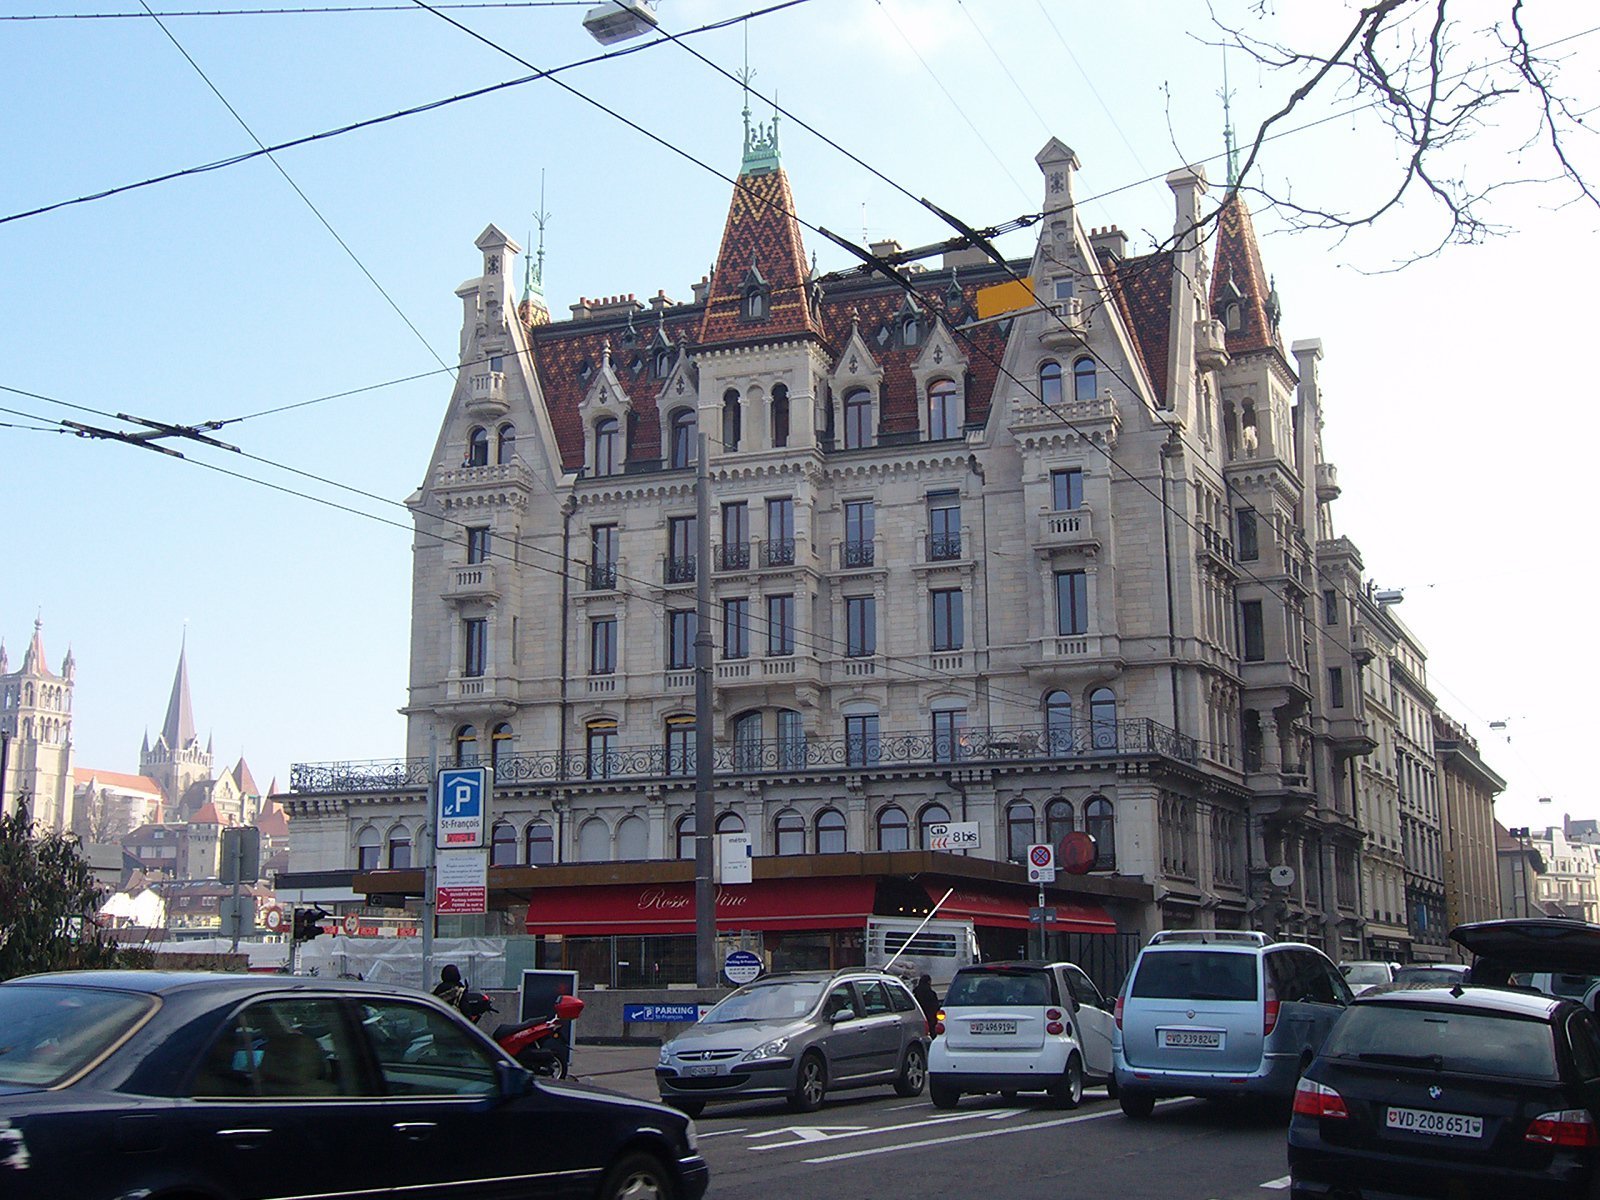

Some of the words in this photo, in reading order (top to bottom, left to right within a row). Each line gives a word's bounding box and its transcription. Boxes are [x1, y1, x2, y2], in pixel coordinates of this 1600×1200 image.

[455, 785, 471, 813] P
[441, 819, 480, 829] St-François
[953, 831, 961, 843] 8
[962, 831, 977, 842] bis
[637, 888, 690, 910] Rosso
[655, 1006, 694, 1015] PARKING
